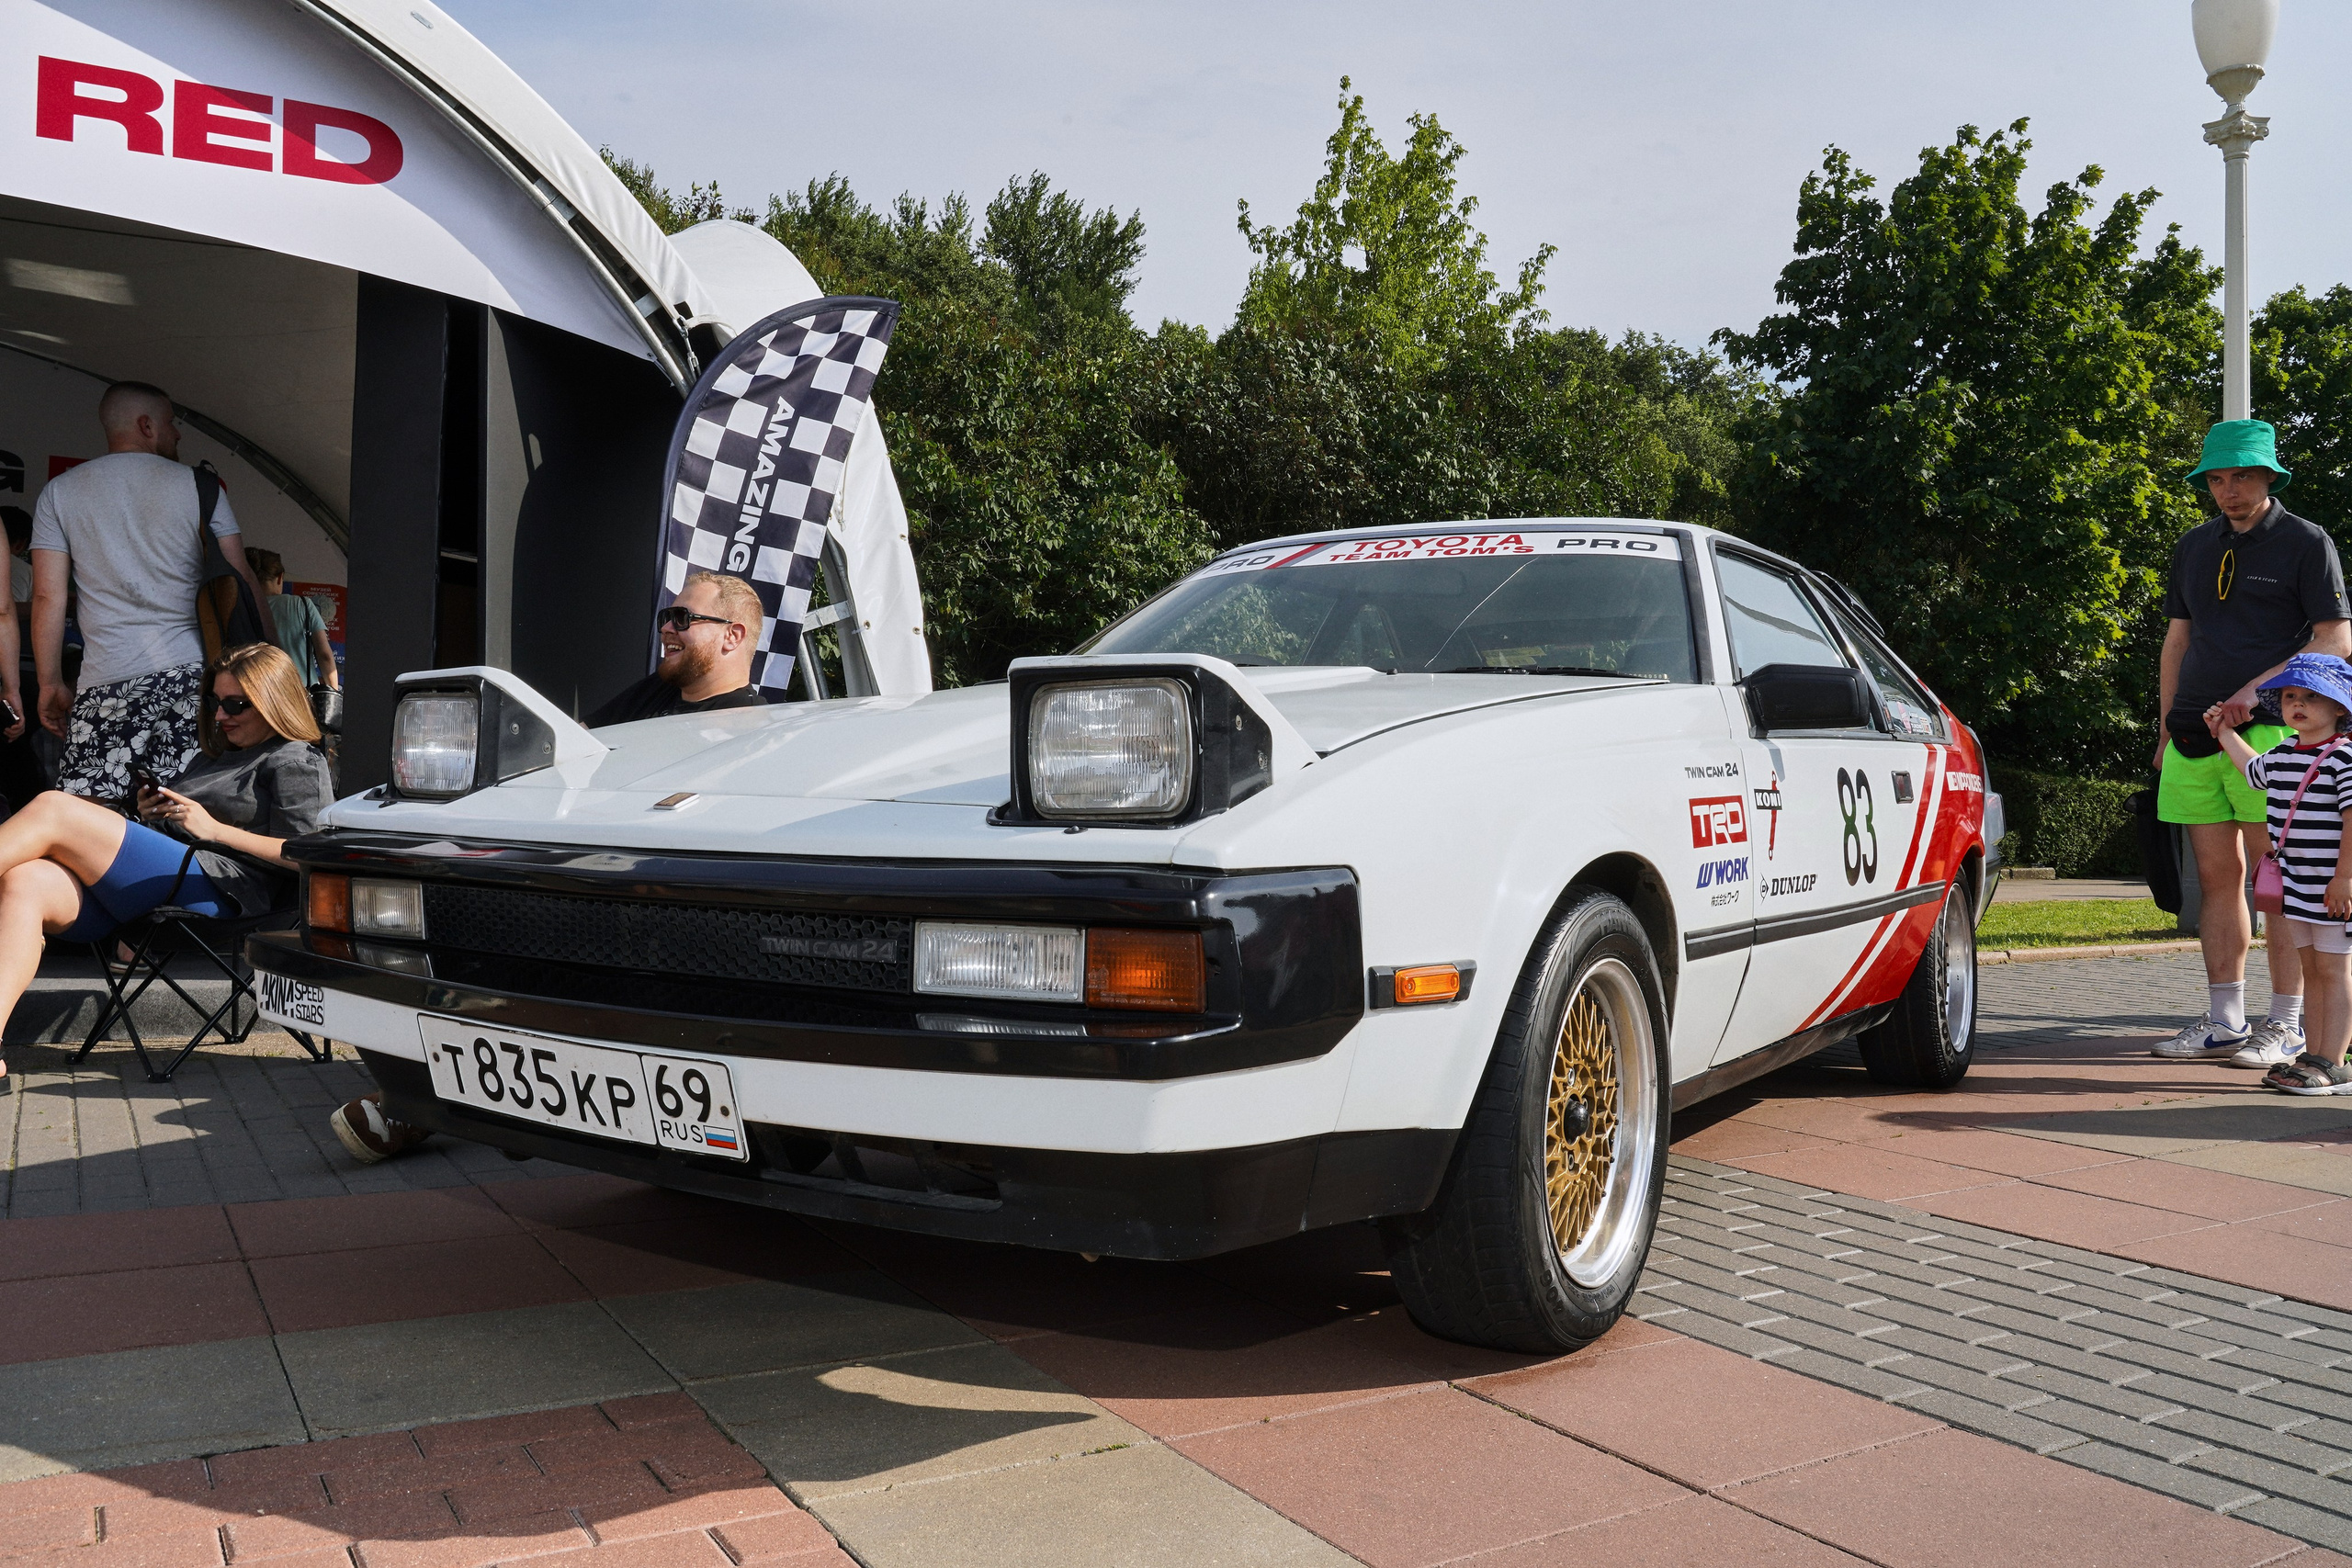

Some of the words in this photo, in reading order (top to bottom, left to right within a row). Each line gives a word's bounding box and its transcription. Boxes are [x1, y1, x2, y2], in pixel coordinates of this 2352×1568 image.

[36, 55, 404, 186] RED
[726, 396, 796, 572] AMAZING
[1329, 550, 1411, 562] TEAM
[1426, 545, 1535, 557] TOM'S
[1353, 535, 1524, 552] TOYOTA
[1556, 538, 1658, 552] PRO
[1204, 555, 1276, 575] PRO
[1684, 766, 1706, 779] TWIN
[1706, 766, 1724, 778] CAM
[1725, 762, 1739, 777] 24
[1756, 791, 1781, 807] KONI
[1692, 801, 1744, 846] TRD
[1838, 767, 1878, 886] 83
[1715, 856, 1749, 886] WORK
[1770, 874, 1816, 897] DUNLOP
[762, 937, 809, 954] TWIN
[812, 942, 858, 959] CAM
[862, 940, 894, 961] 24
[260, 972, 294, 1019] AKINA
[294, 980, 324, 1003] SPEED
[295, 1003, 324, 1026] STARS
[655, 1064, 712, 1122] 69
[659, 1119, 704, 1144] RUS
